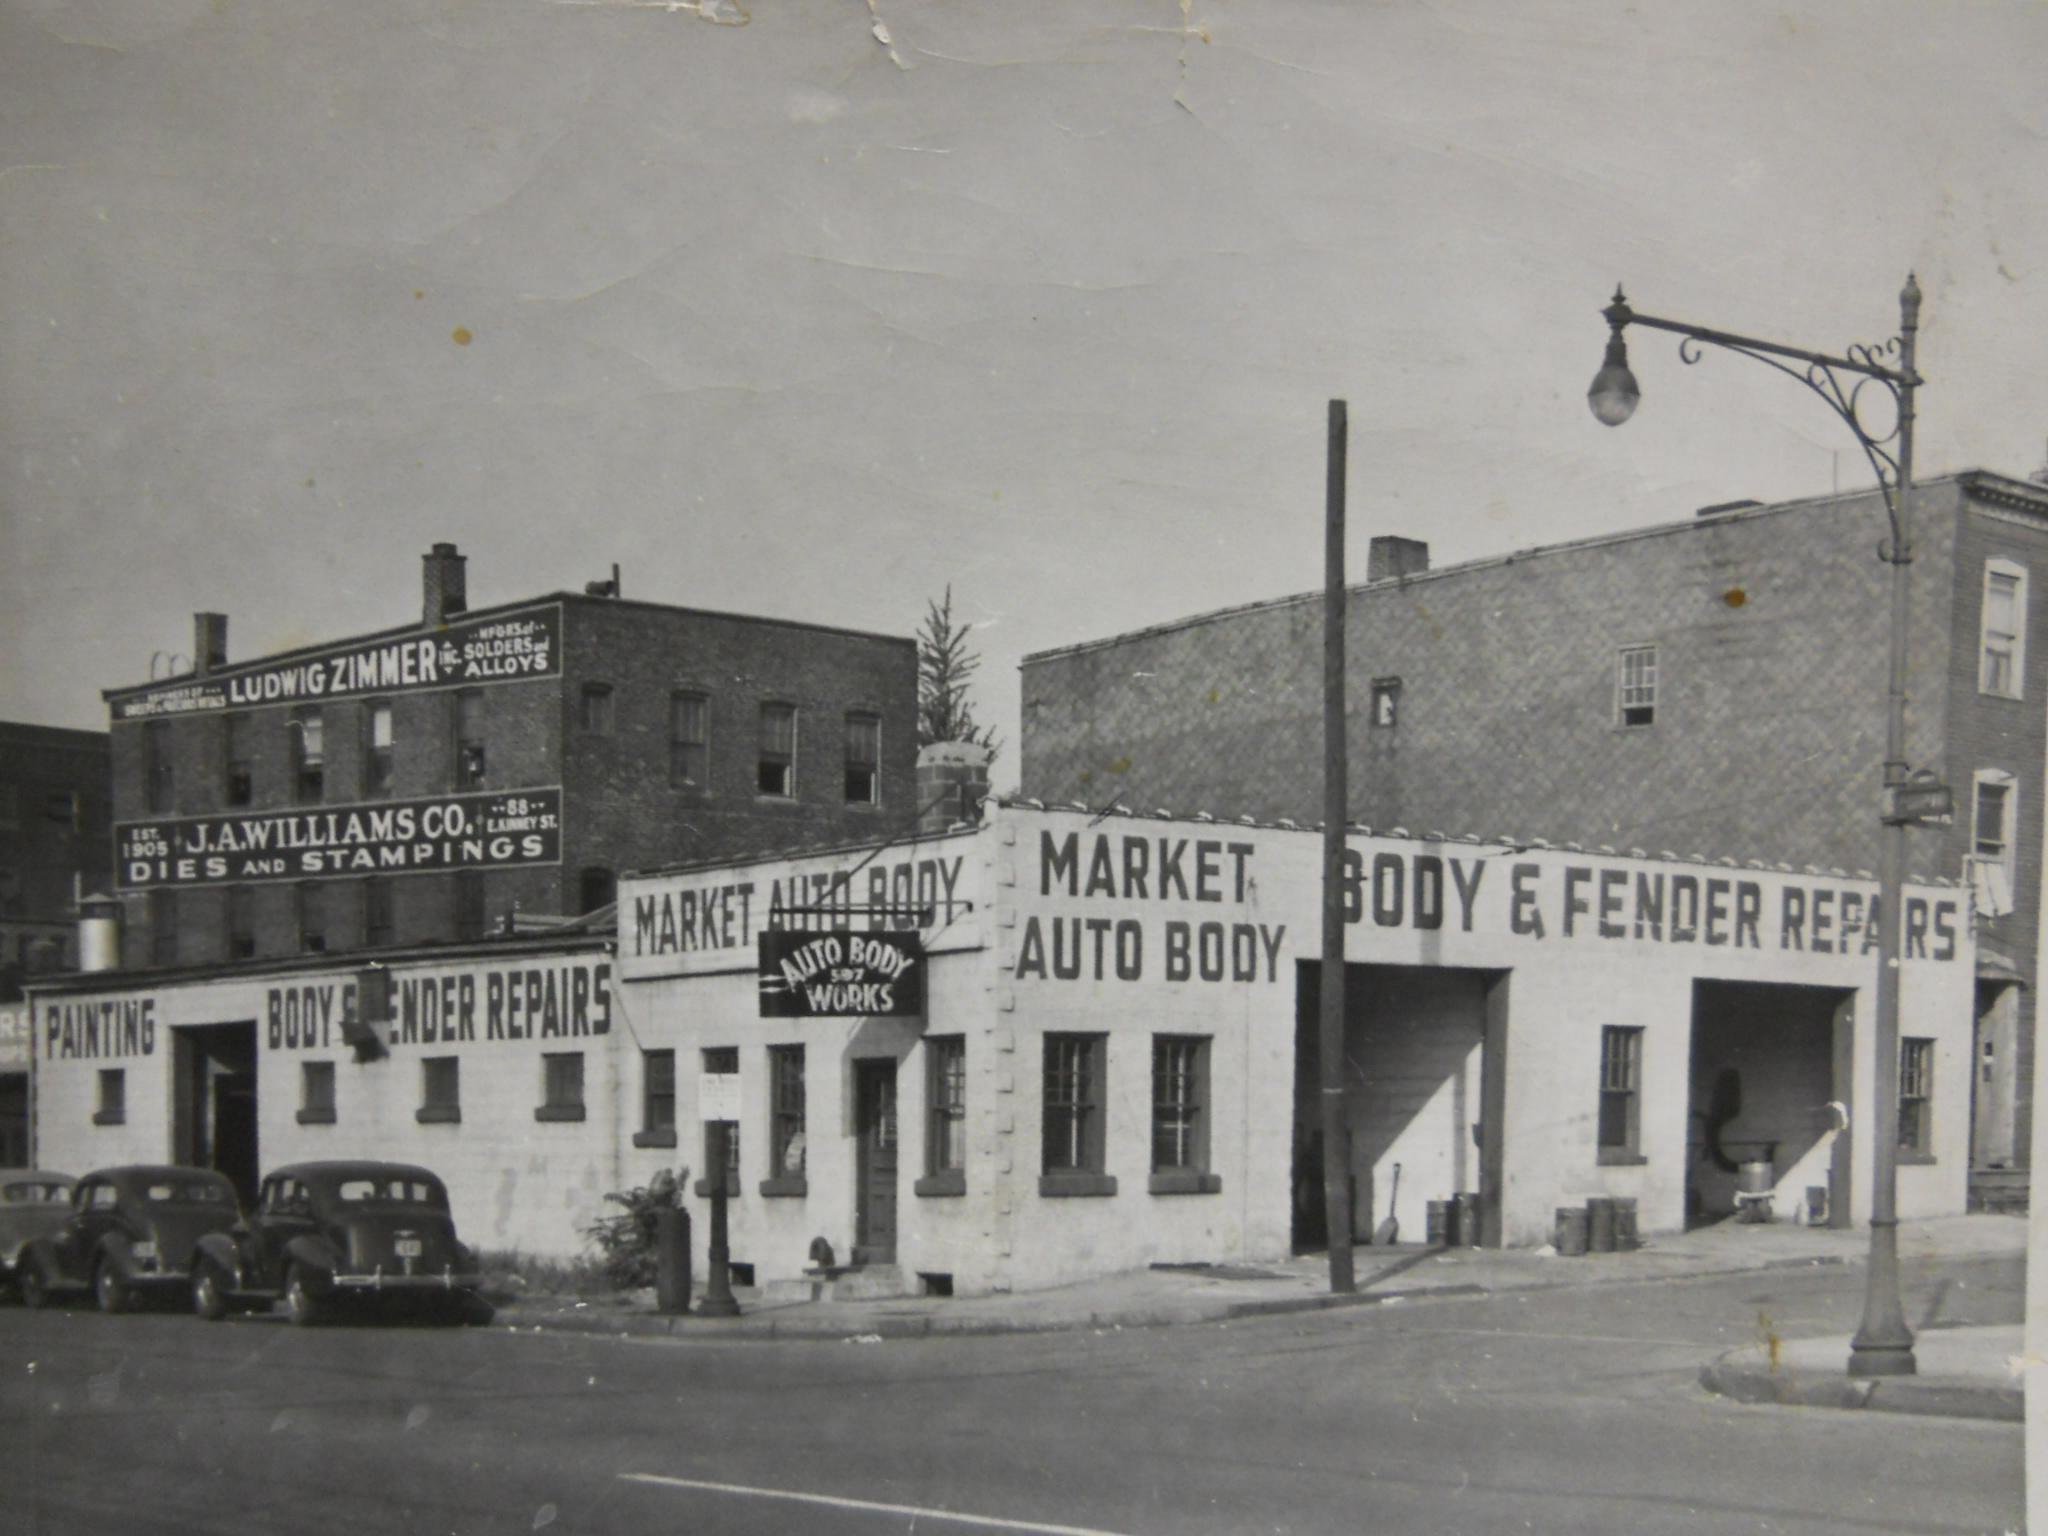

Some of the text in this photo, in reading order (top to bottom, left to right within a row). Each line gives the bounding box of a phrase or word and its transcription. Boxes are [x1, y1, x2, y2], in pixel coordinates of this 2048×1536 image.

[464, 636, 533, 660] SOLDERS
[464, 652, 548, 677] ALLOYS
[230, 640, 462, 702] LUDWIG ZIMMER INC.
[422, 803, 474, 839] CO.
[506, 799, 528, 816] 88
[540, 815, 558, 829] ST.
[123, 841, 169, 858] 1905
[132, 827, 160, 841] EST.
[130, 835, 543, 882] DIES AND STAMPINGS
[1040, 830, 1255, 903] MARKET
[636, 856, 964, 956] MARKET AUTO BODY
[1344, 848, 1957, 962] BODY & FENDER REPARS
[780, 936, 915, 993] AUTO BODY
[1015, 915, 1287, 984] AUTO BODY
[47, 999, 155, 1060] PAINTING
[268, 984, 334, 1050] BODY
[388, 973, 475, 1046] ENDER
[486, 963, 612, 1041] REPAIRS
[804, 984, 895, 1012] WORKS
